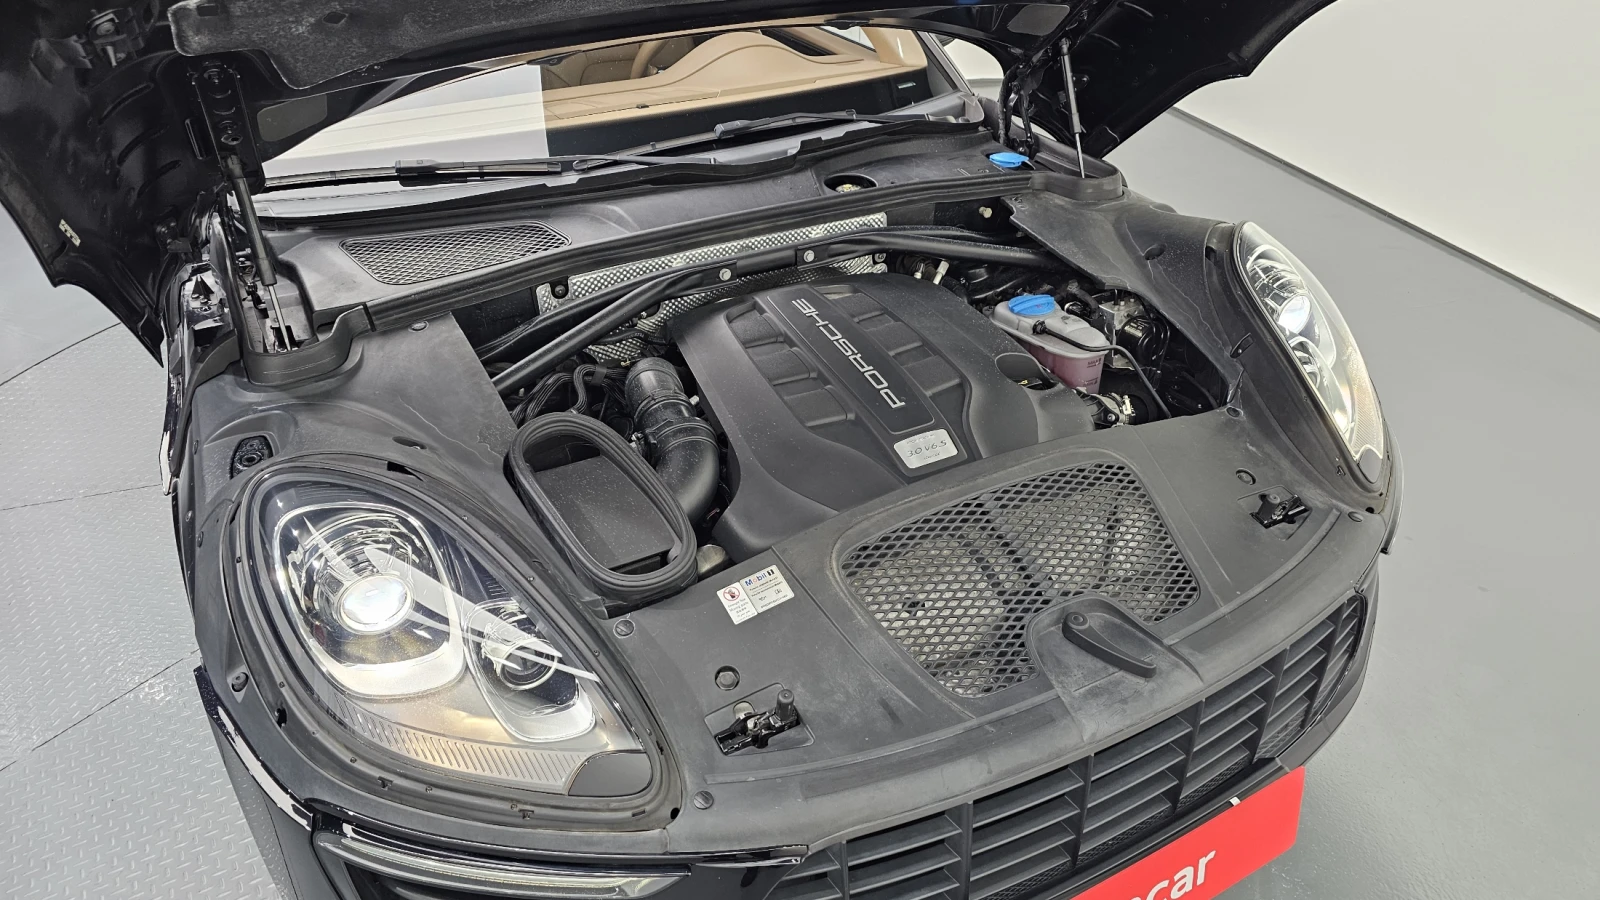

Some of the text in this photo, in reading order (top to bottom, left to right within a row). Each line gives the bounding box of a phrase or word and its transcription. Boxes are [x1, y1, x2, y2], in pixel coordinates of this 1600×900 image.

[791, 298, 906, 409] PORSCHE
[907, 447, 923, 458] 3.0
[745, 573, 767, 586] Mobil
[1130, 850, 1216, 900] car
